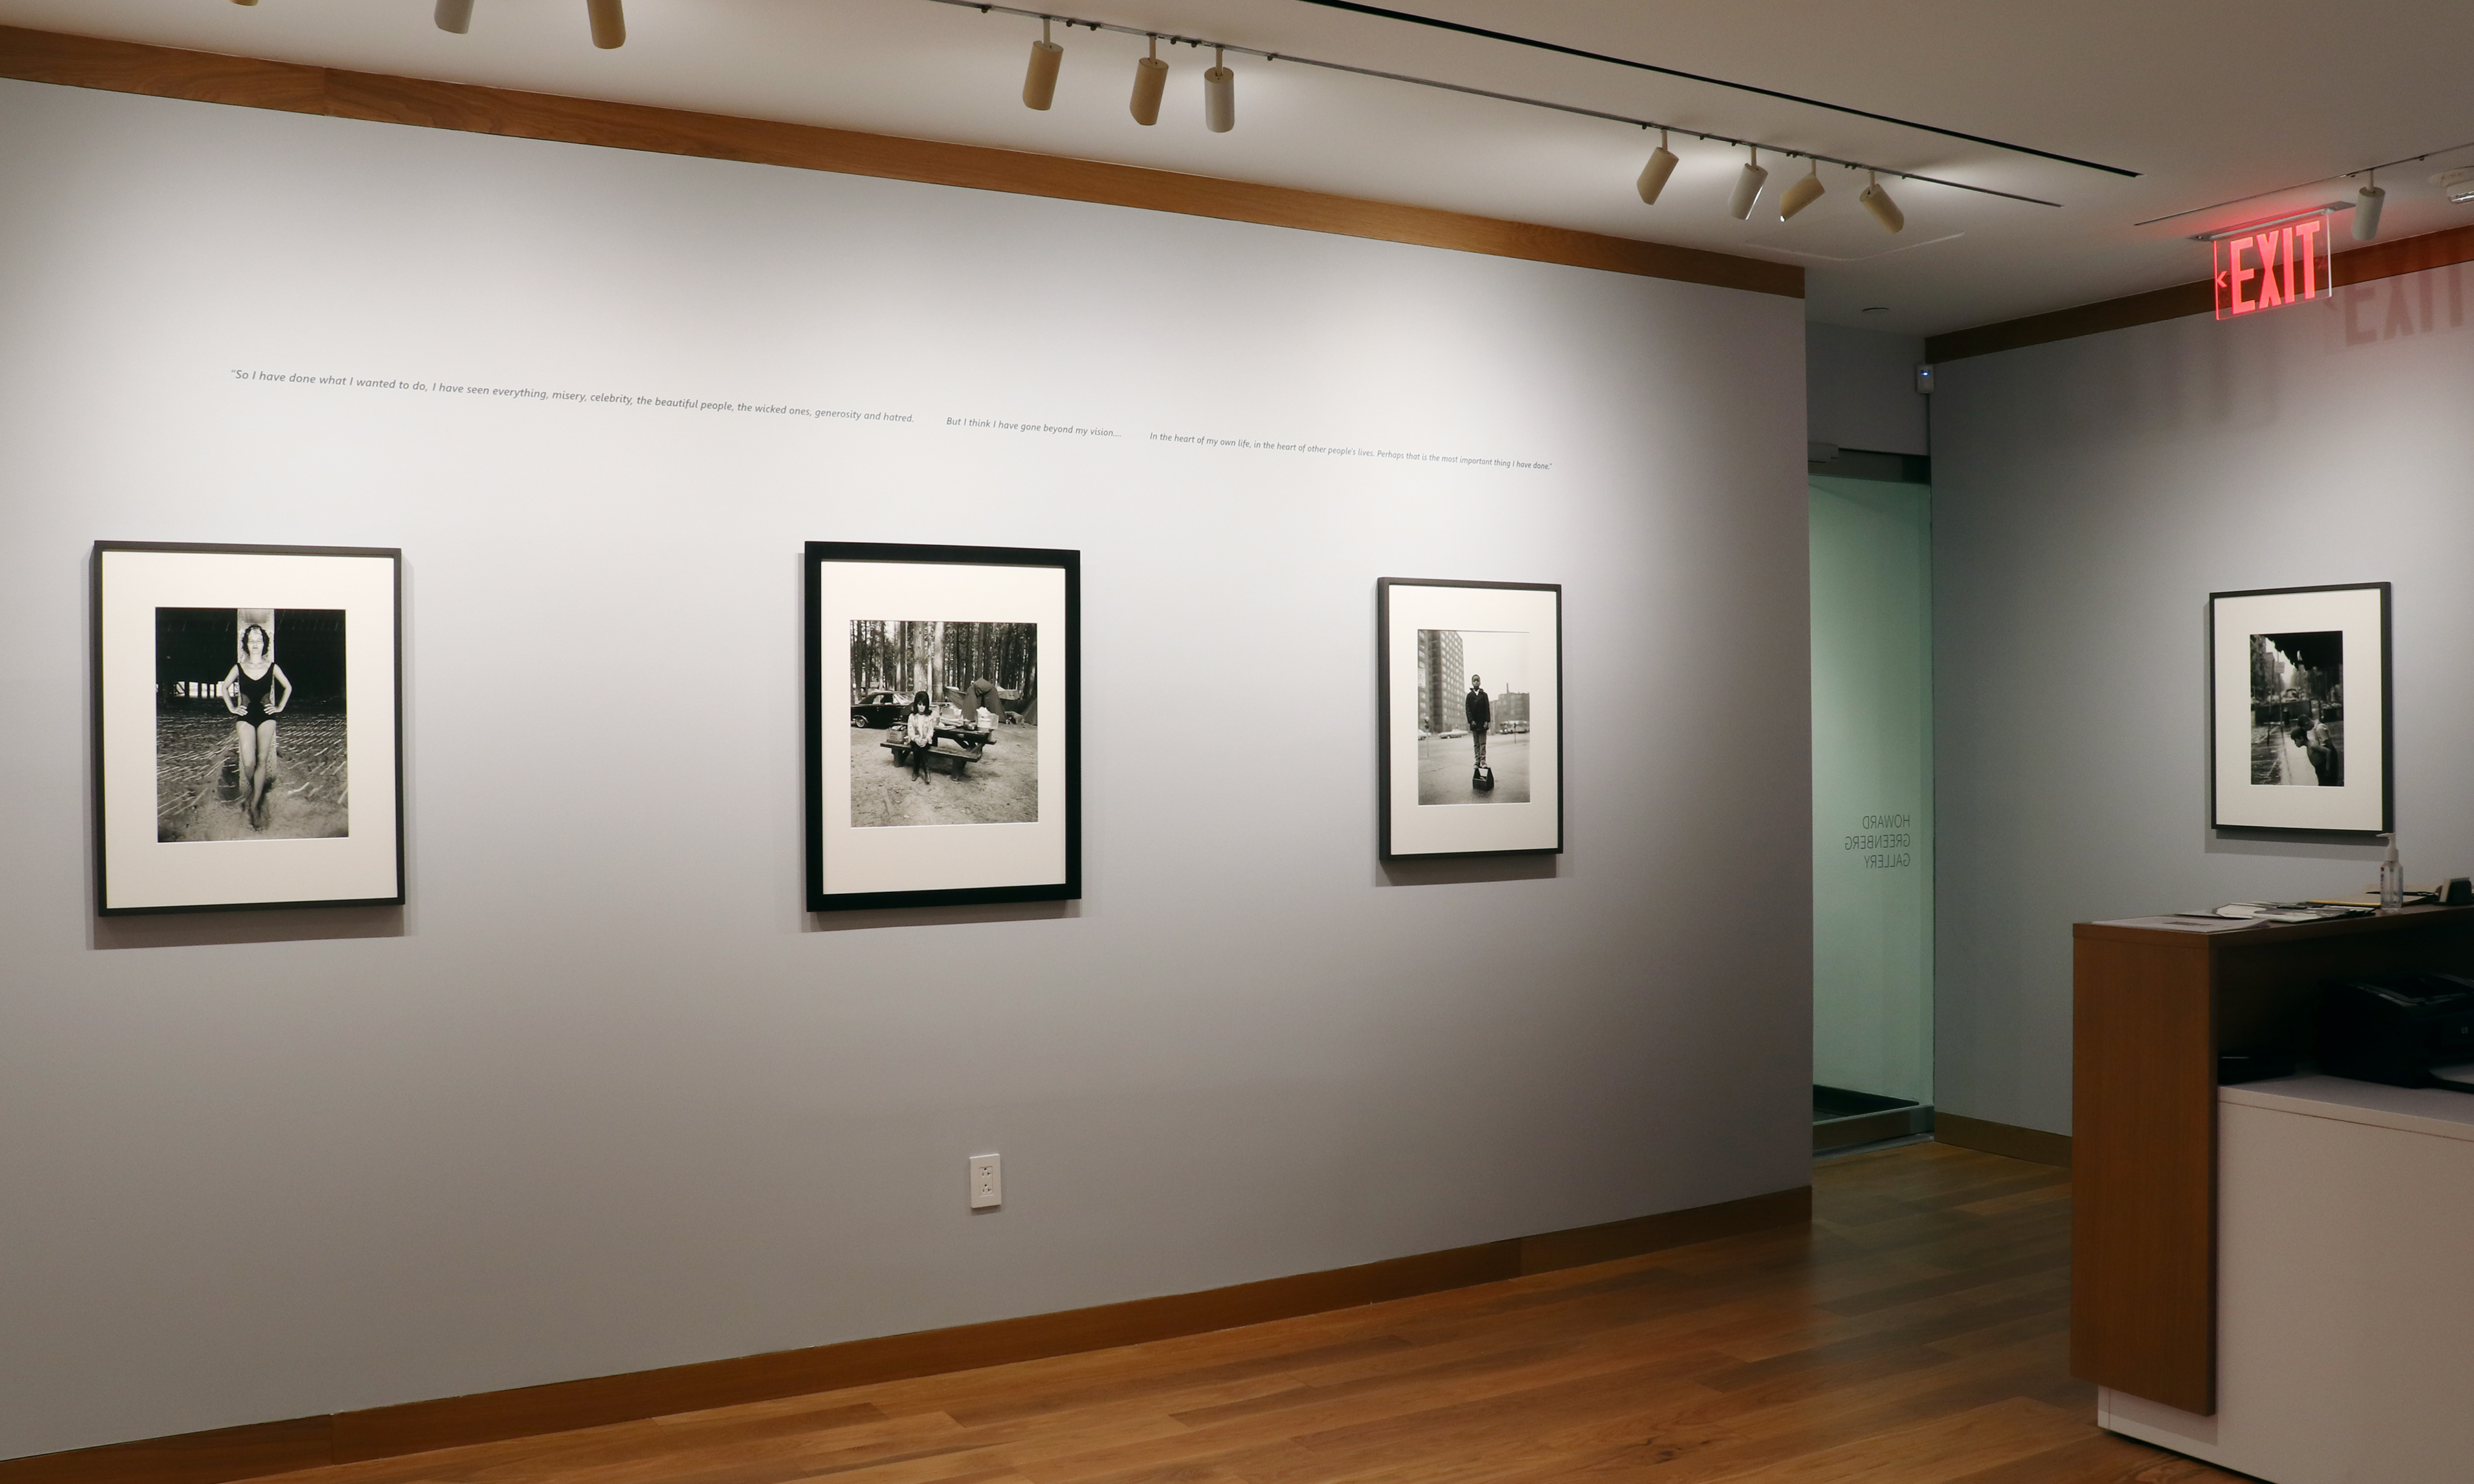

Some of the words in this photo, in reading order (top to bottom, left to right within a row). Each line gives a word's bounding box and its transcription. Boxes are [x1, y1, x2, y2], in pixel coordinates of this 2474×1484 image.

[2229, 220, 2321, 315] EXIT
[252, 370, 256, 380] I
[258, 370, 287, 382] have
[289, 372, 316, 384] done
[319, 374, 347, 385] what
[349, 376, 354, 386] I
[356, 379, 397, 389] wanted
[399, 381, 410, 390] to
[412, 381, 428, 392] do,
[432, 382, 436, 392] I
[438, 382, 465, 394] have
[466, 386, 490, 395] seen
[492, 387, 549, 401] everything,
[552, 390, 588, 403] misery,
[590, 392, 633, 406] celebrity,
[636, 395, 653, 405] the
[654, 396, 699, 409] beautiful
[700, 401, 735, 412] people,
[737, 402, 753, 412] the
[755, 403, 788, 414] wicked
[788, 407, 812, 417] ones,
[814, 409, 862, 421] generosity
[863, 412, 882, 420] and
[883, 412, 914, 423] hatred.
[946, 416, 962, 426] But
[963, 418, 967, 426] I
[968, 418, 992, 428] think
[992, 420, 996, 428] I
[998, 420, 1019, 430] have
[1020, 424, 1042, 433] gone
[1043, 423, 1074, 435] beyond
[1075, 427, 1089, 437] my
[1149, 431, 1158, 440] In
[1159, 432, 1172, 442] the
[1174, 434, 1196, 444] heart
[1196, 436, 1206, 446] of
[1205, 438, 1219, 447] my
[1238, 438, 1251, 449] life,
[1253, 440, 1261, 449] in
[1262, 440, 1275, 450] the
[1276, 442, 1297, 451] heart
[1297, 443, 1306, 453] of
[1306, 445, 1327, 453] other
[1357, 447, 1375, 457] lives.
[1377, 449, 1405, 461] Perhaps
[1405, 451, 1420, 460] that
[1421, 453, 1427, 461] is
[1429, 453, 1440, 462] the
[1459, 456, 1493, 466] important
[1493, 458, 1511, 469] thing
[1515, 460, 1532, 469] have
